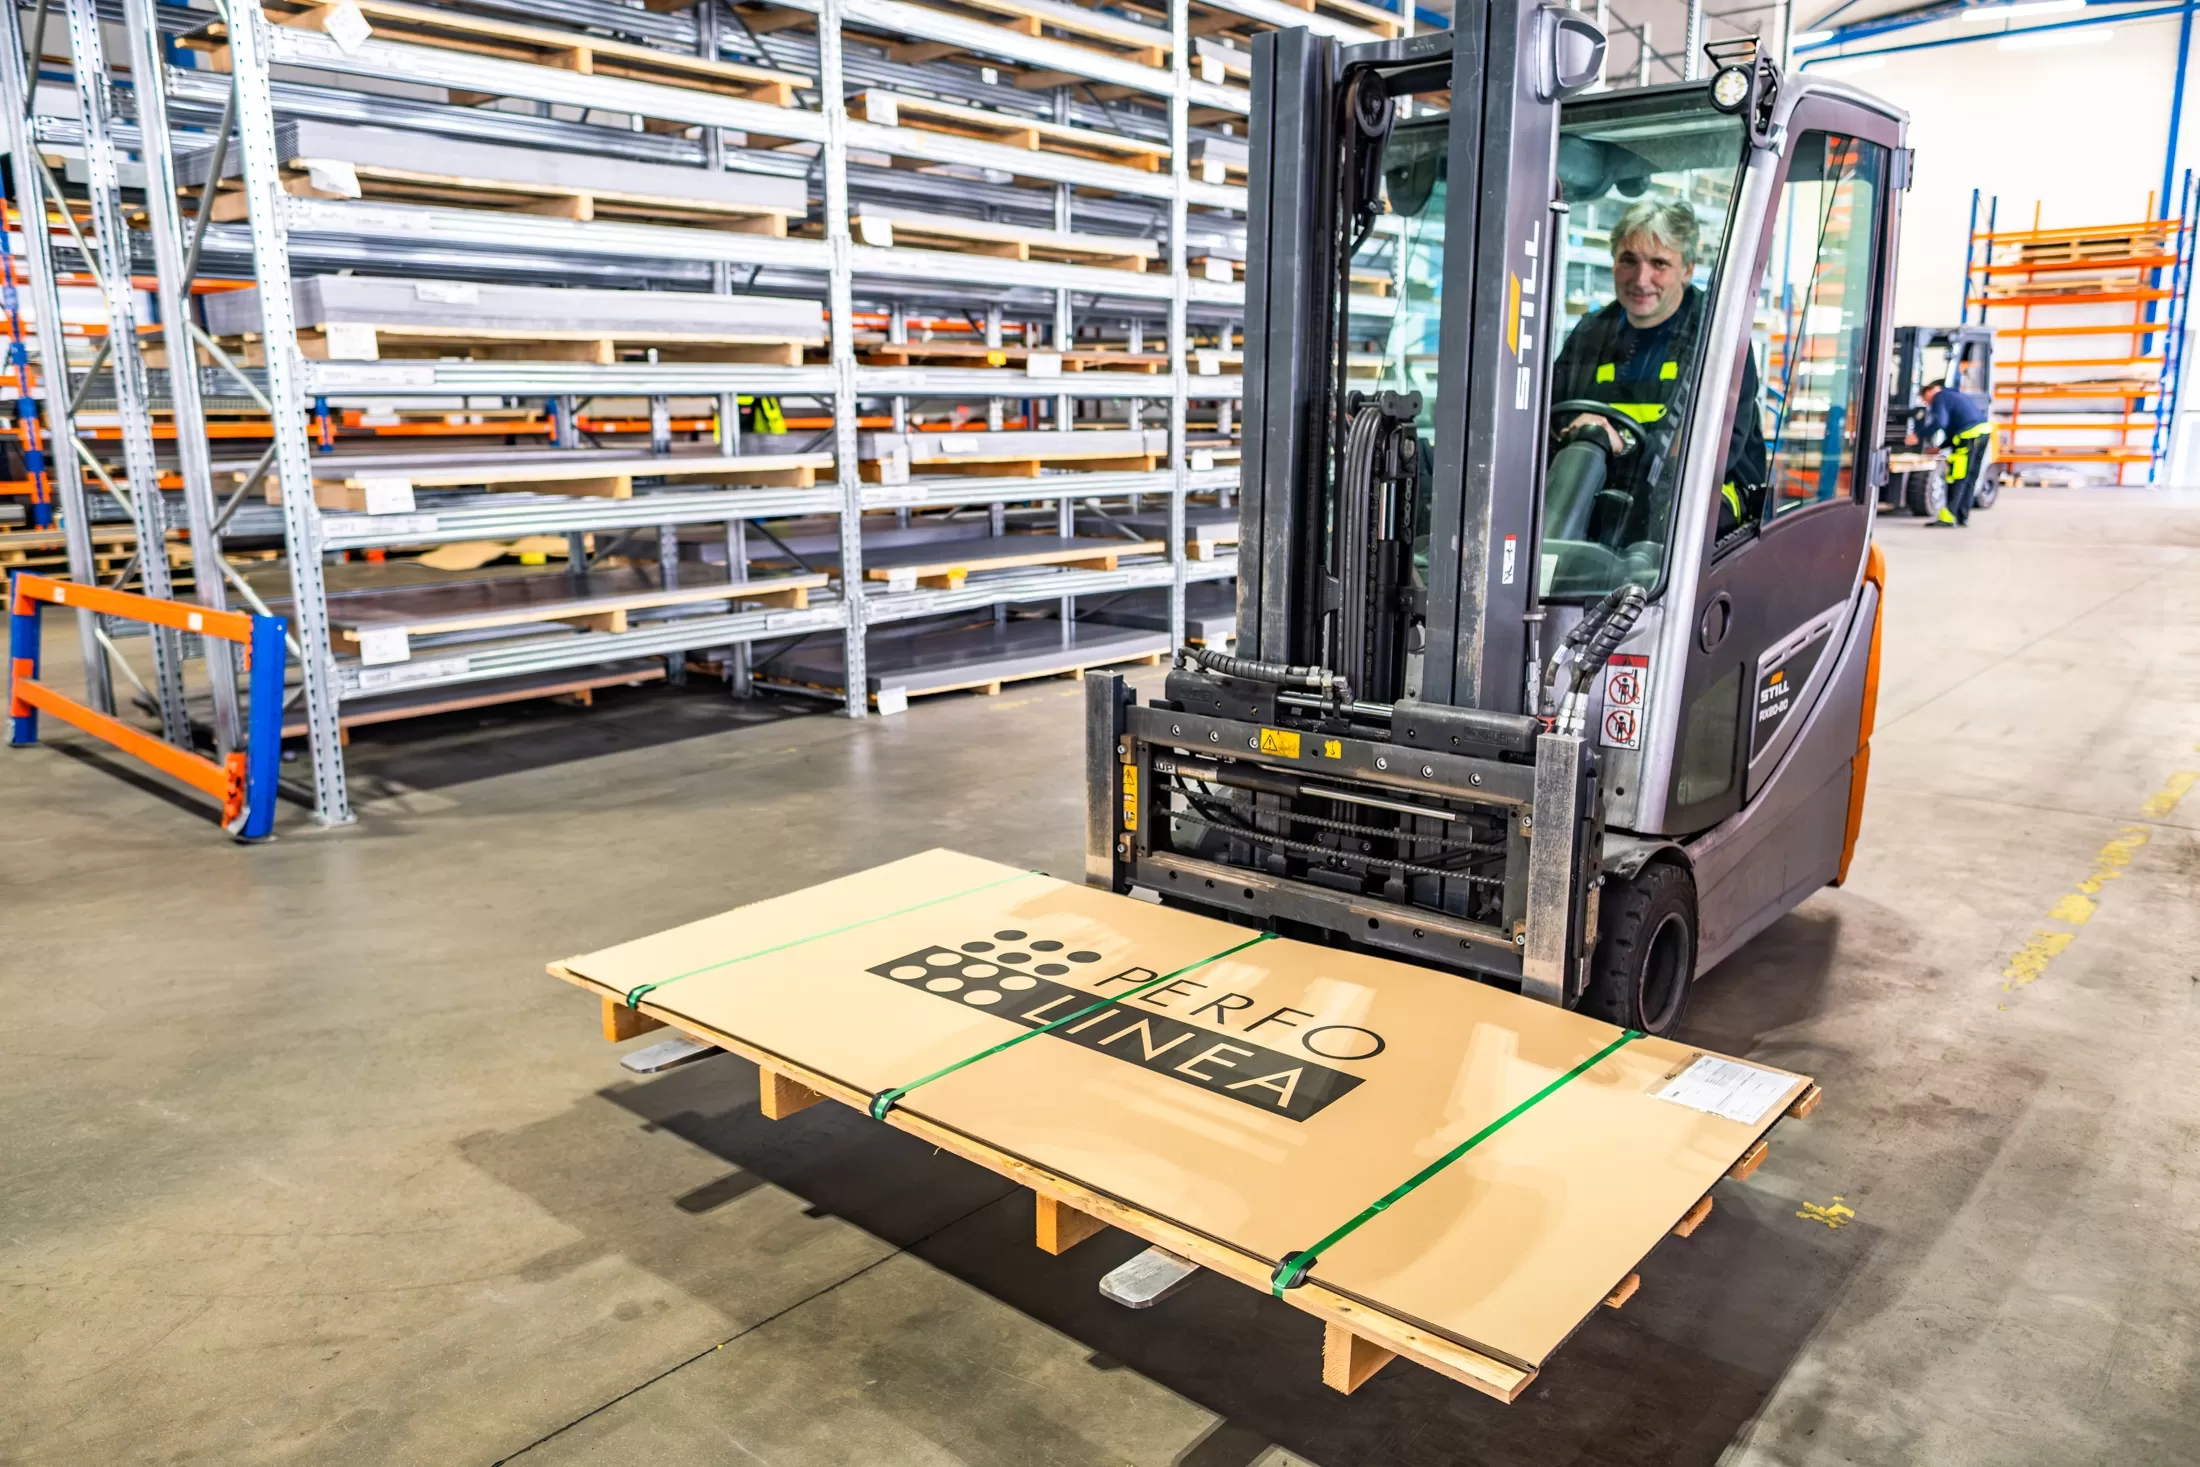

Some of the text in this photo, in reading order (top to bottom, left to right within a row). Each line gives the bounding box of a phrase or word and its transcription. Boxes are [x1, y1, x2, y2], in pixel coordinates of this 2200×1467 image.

[1515, 219, 1540, 410] STILL
[1760, 680, 1790, 704] STILL
[1020, 995, 1307, 1109] LINEA
[1094, 966, 1386, 1060] PERFO
